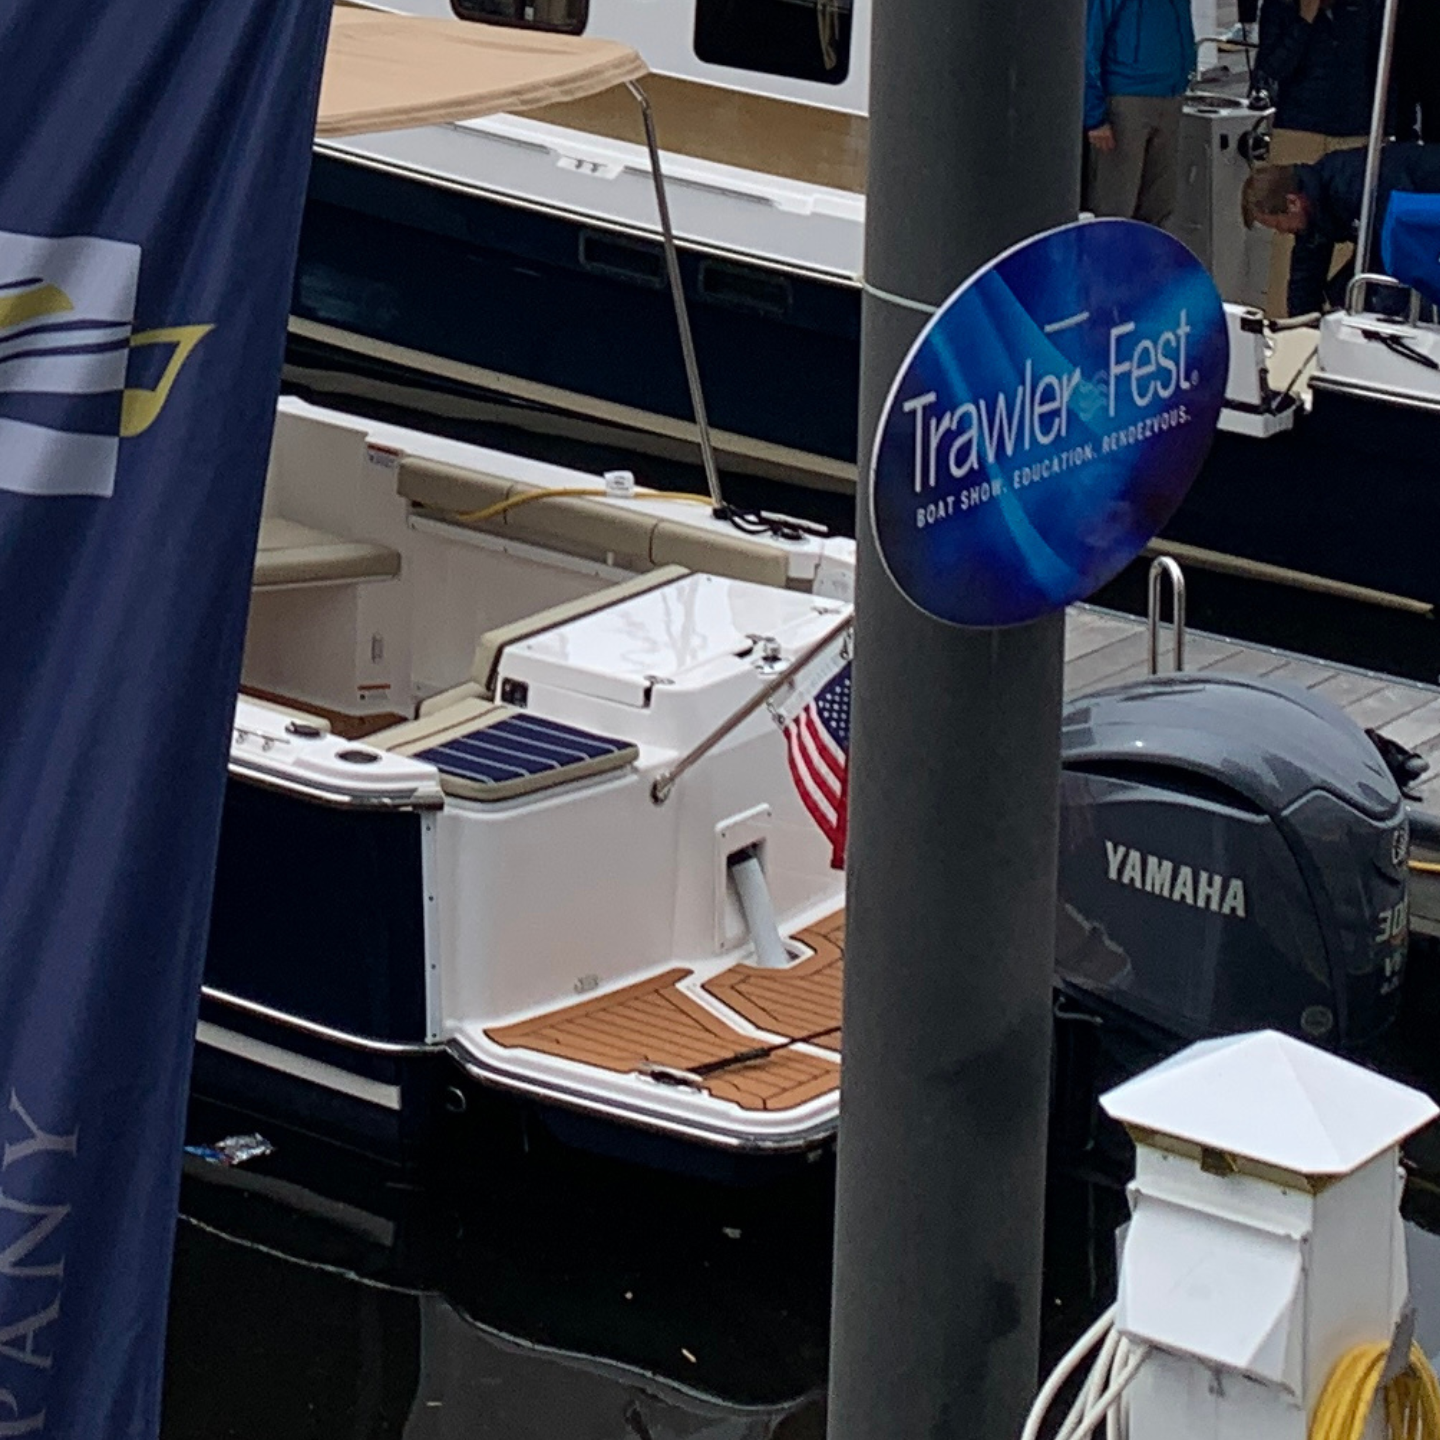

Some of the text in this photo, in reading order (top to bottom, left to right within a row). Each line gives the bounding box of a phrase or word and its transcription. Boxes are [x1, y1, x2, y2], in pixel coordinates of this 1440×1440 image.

[903, 358, 1083, 494] Trawler
[916, 404, 1192, 528] BOAT SHOW. EDUCATION. RENDEZVOUS.
[1104, 839, 1247, 919] YAMAHA
[1375, 896, 1408, 943] 30
